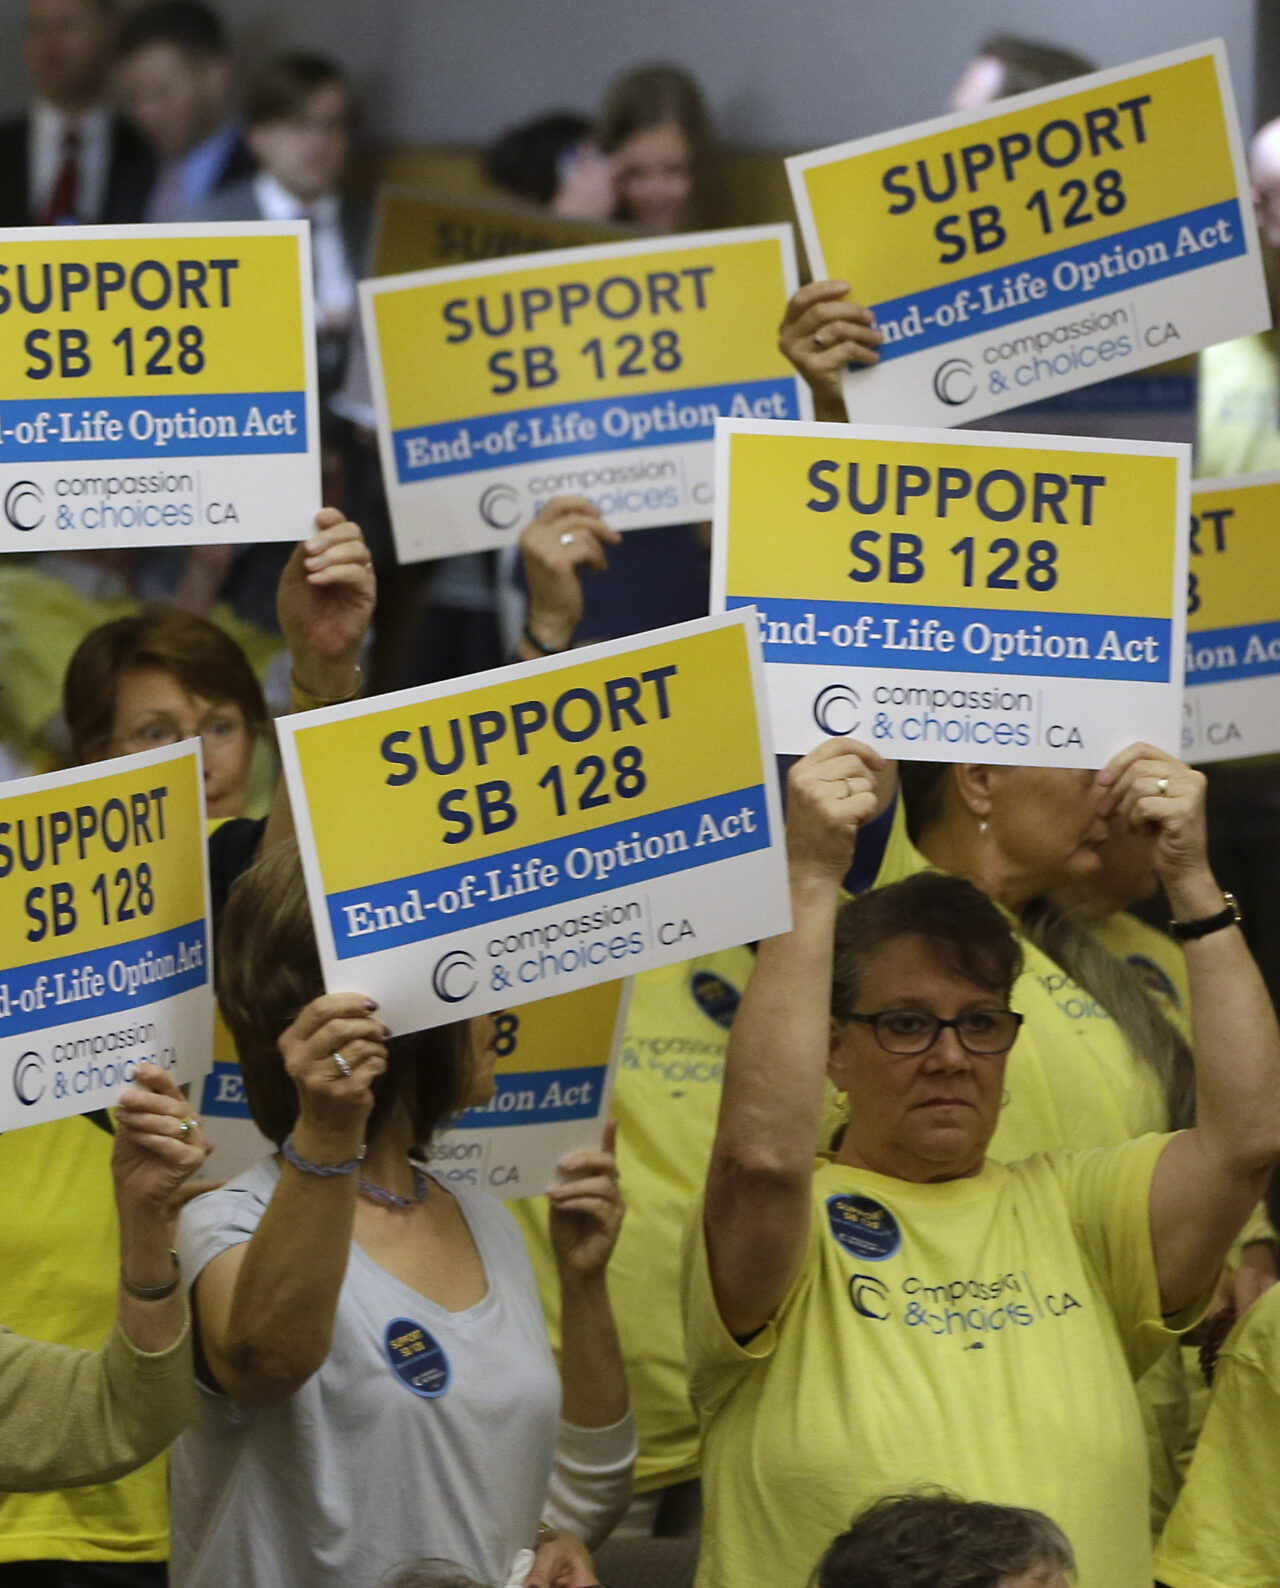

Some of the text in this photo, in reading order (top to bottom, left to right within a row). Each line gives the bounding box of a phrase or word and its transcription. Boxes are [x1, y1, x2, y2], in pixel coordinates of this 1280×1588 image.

[882, 94, 1152, 216] SUPPORT
[934, 168, 1127, 265] SB 128
[442, 266, 715, 344] SUPPORT
[875, 217, 1233, 343] nd-of-Life Option Act
[24, 325, 205, 380] SB 128
[488, 329, 682, 395] SB 128
[982, 306, 1128, 364] compassion
[988, 322, 1180, 395] & choices CA
[129, 407, 237, 446] Option
[244, 406, 297, 437] Act
[406, 391, 787, 469] End-of-Life Option Act
[55, 471, 193, 501] compassion
[528, 458, 677, 493] compassion
[596, 482, 714, 515] oices C
[806, 459, 1106, 526] SUPPORT
[56, 501, 239, 530] & choices CA
[848, 530, 1058, 592] SB 128
[754, 614, 1160, 664] End-of-Life Option Act
[1185, 634, 1280, 674] ion Ac
[380, 664, 678, 787] SUPPORT
[873, 685, 1033, 714] compassion
[874, 713, 1084, 750] & choices CA
[1207, 720, 1243, 747] CA
[437, 745, 648, 845] SB 128
[25, 861, 155, 943] SB 128
[341, 807, 758, 939] End-of-Life Option Act
[486, 899, 643, 959] compassion
[490, 918, 698, 992] & choices CA
[107, 950, 177, 998] Option
[175, 939, 204, 975] Act
[52, 1020, 156, 1065] compassion
[53, 1072, 70, 1100] &
[534, 1080, 593, 1108] Act
[489, 1165, 521, 1187] CA
[1045, 1291, 1082, 1316] CA
